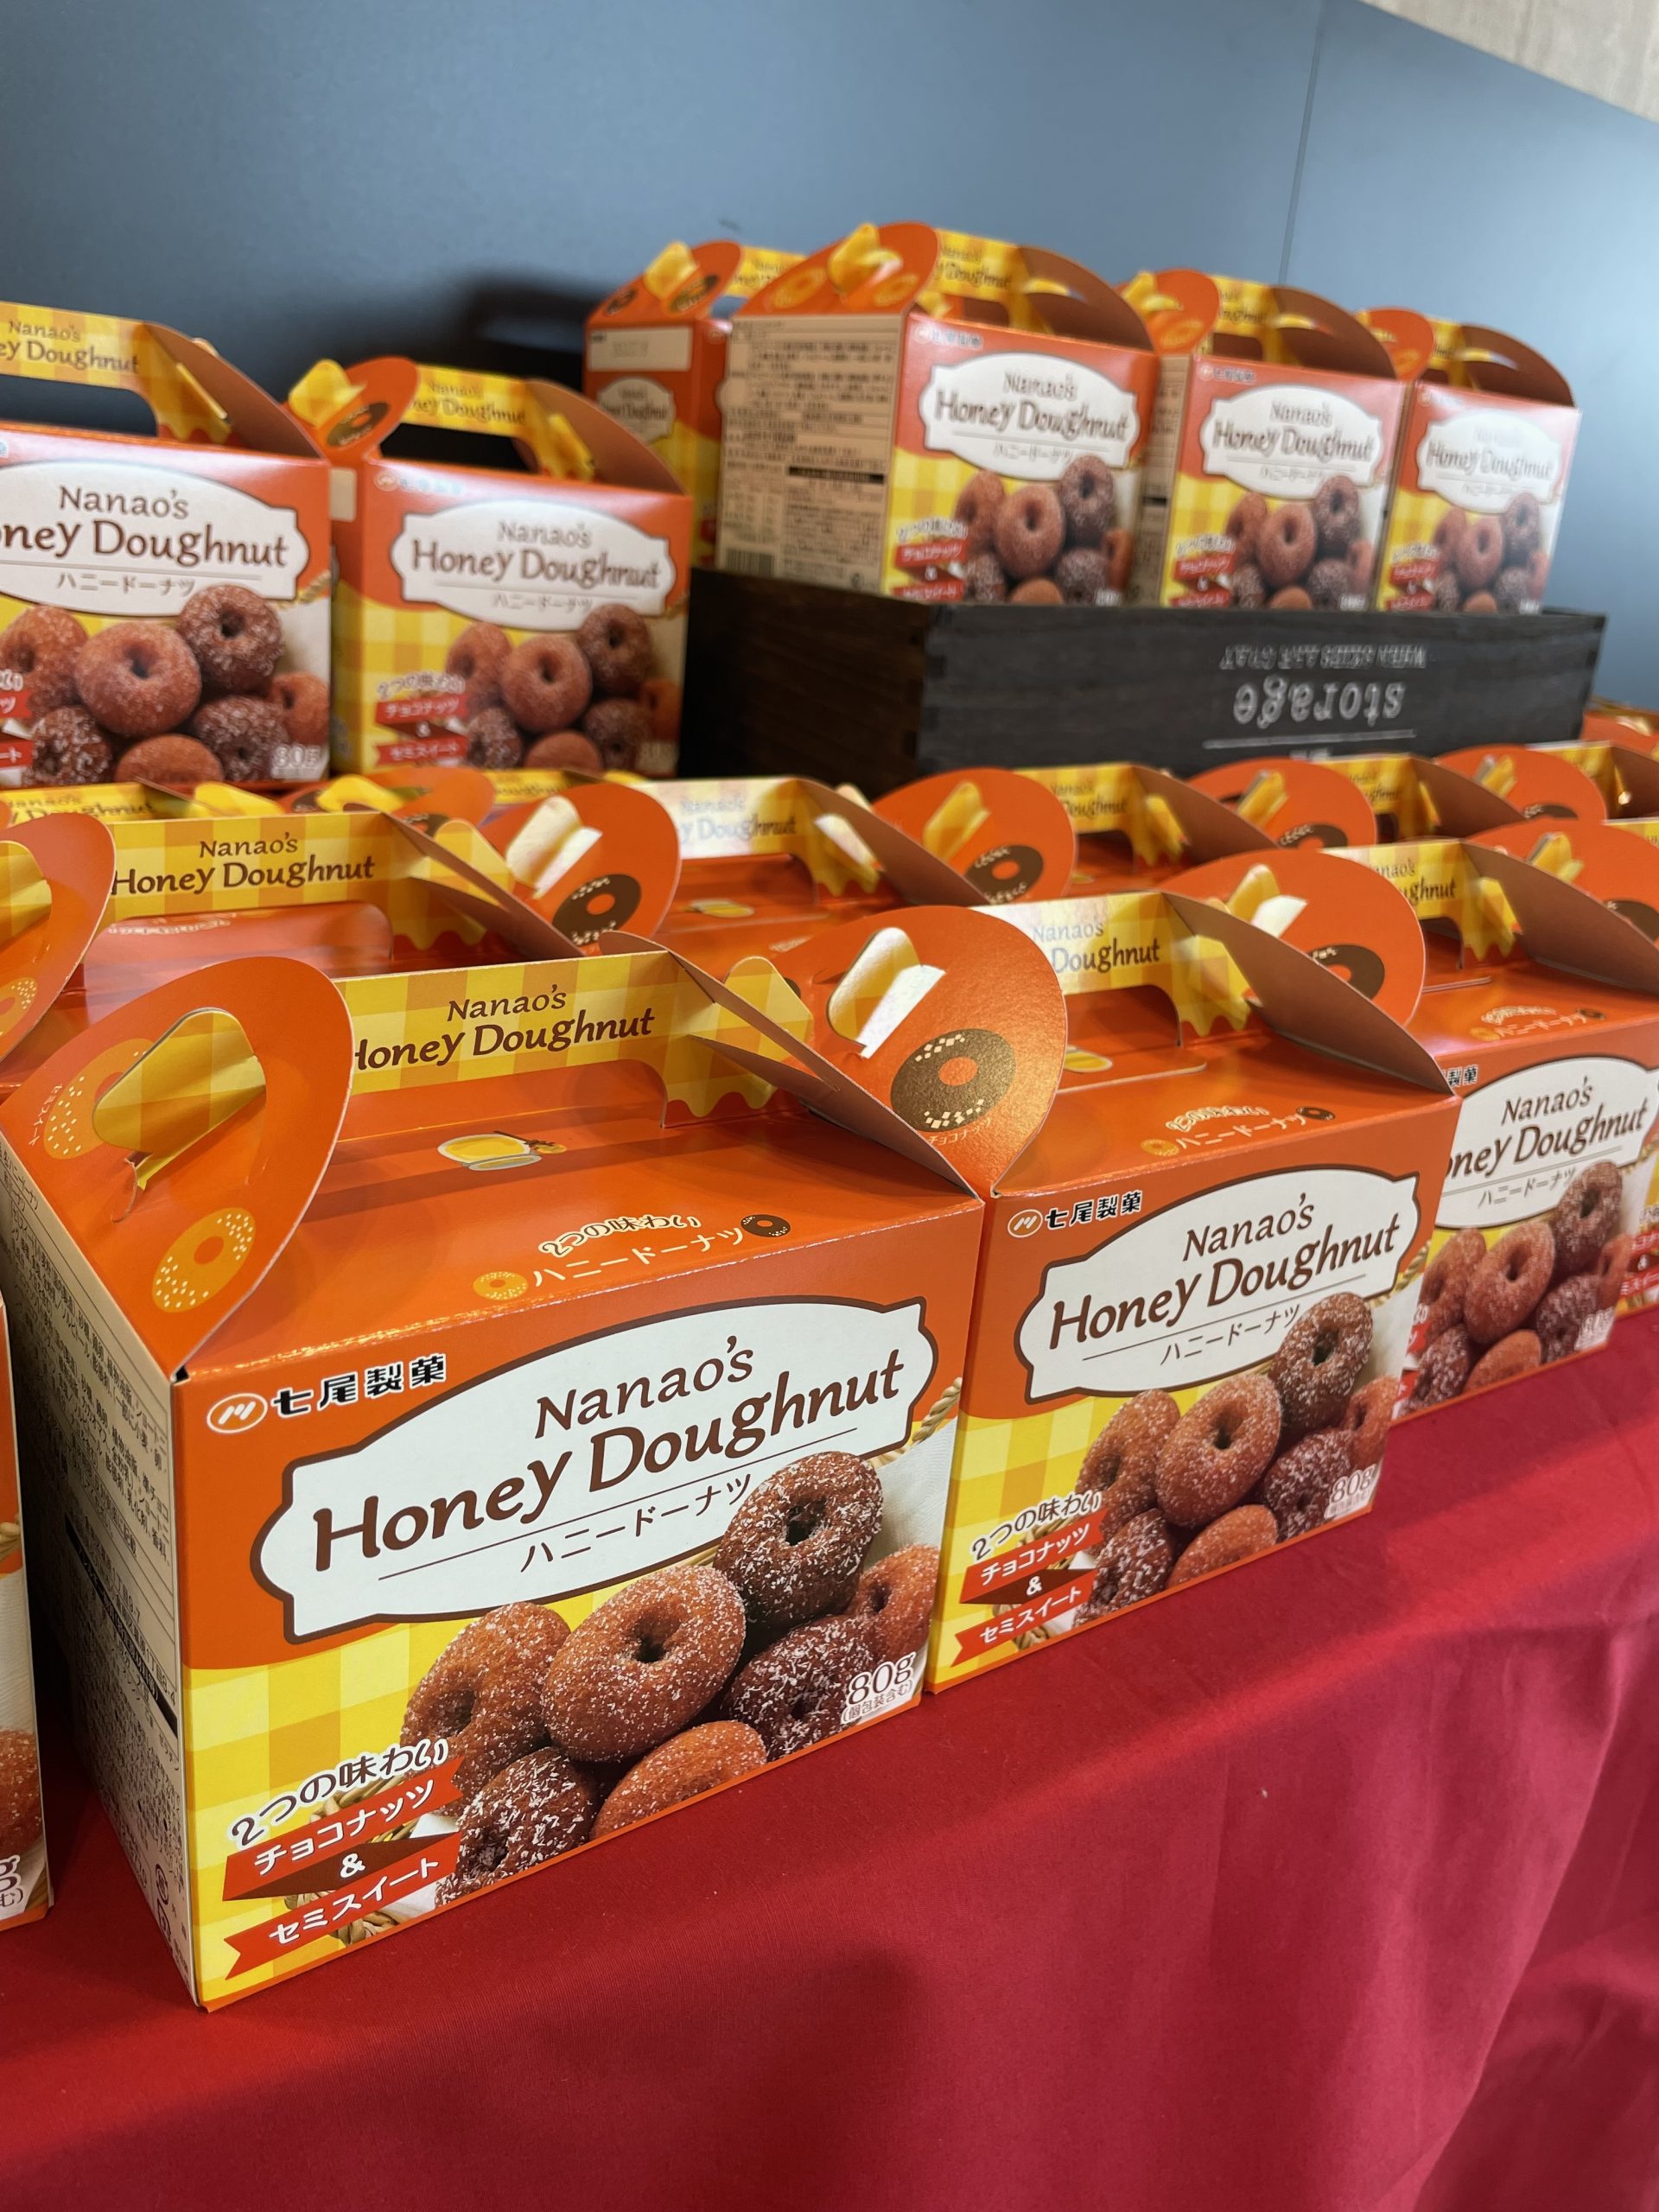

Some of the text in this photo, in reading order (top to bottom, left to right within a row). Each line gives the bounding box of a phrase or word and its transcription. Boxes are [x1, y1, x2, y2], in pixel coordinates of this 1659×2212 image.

[27, 340, 139, 373] Doughnut
[934, 390, 1129, 440] Honey Doughnut
[59, 484, 190, 519] Nanao's
[0, 518, 289, 569] ney Doughnut
[496, 520, 594, 550] Nanao's
[57, 572, 197, 596] ハニードーナツ
[410, 537, 664, 590] Honey Doughnut
[1232, 674, 1407, 729] storage
[199, 830, 299, 859] Nanao's
[111, 854, 377, 896] Honey Doughnut
[1032, 920, 1105, 944] Nanao's
[1051, 938, 1160, 975] Doughnut
[447, 983, 568, 1022] Nanao's
[472, 1007, 655, 1057] Doughnut
[1500, 1075, 1593, 1127] Nanao's
[1513, 1097, 1649, 1165] Doughnut
[539, 1213, 702, 1258] 2つの味わい
[1044, 1190, 1143, 1230] 七尾製菓
[1181, 1192, 1315, 1262] Nanao's
[532, 1225, 745, 1288] ハニードーナツ
[1048, 1212, 1401, 1351] Honey Doughnut
[1160, 1303, 1301, 1366] ハニードーナツ
[271, 1353, 448, 1420] 七尾製菓
[534, 1334, 754, 1440] Nanao's
[312, 1348, 906, 1573] Honey Doughnut
[1332, 1464, 1377, 1503] 80g
[520, 1472, 752, 1573] ハニードーナツ
[970, 1491, 1103, 1562] 2つの味わい
[980, 1522, 1090, 1586] チョコナッツ
[1026, 1575, 1043, 1596] &
[979, 1586, 1083, 1644] セミスイート
[847, 1650, 917, 1707] 80g
[228, 1739, 448, 1849] 2つの味わい
[253, 1778, 435, 1876] チョコナッツ
[339, 1853, 366, 1878] &
[268, 1856, 440, 1945] セミスイート
